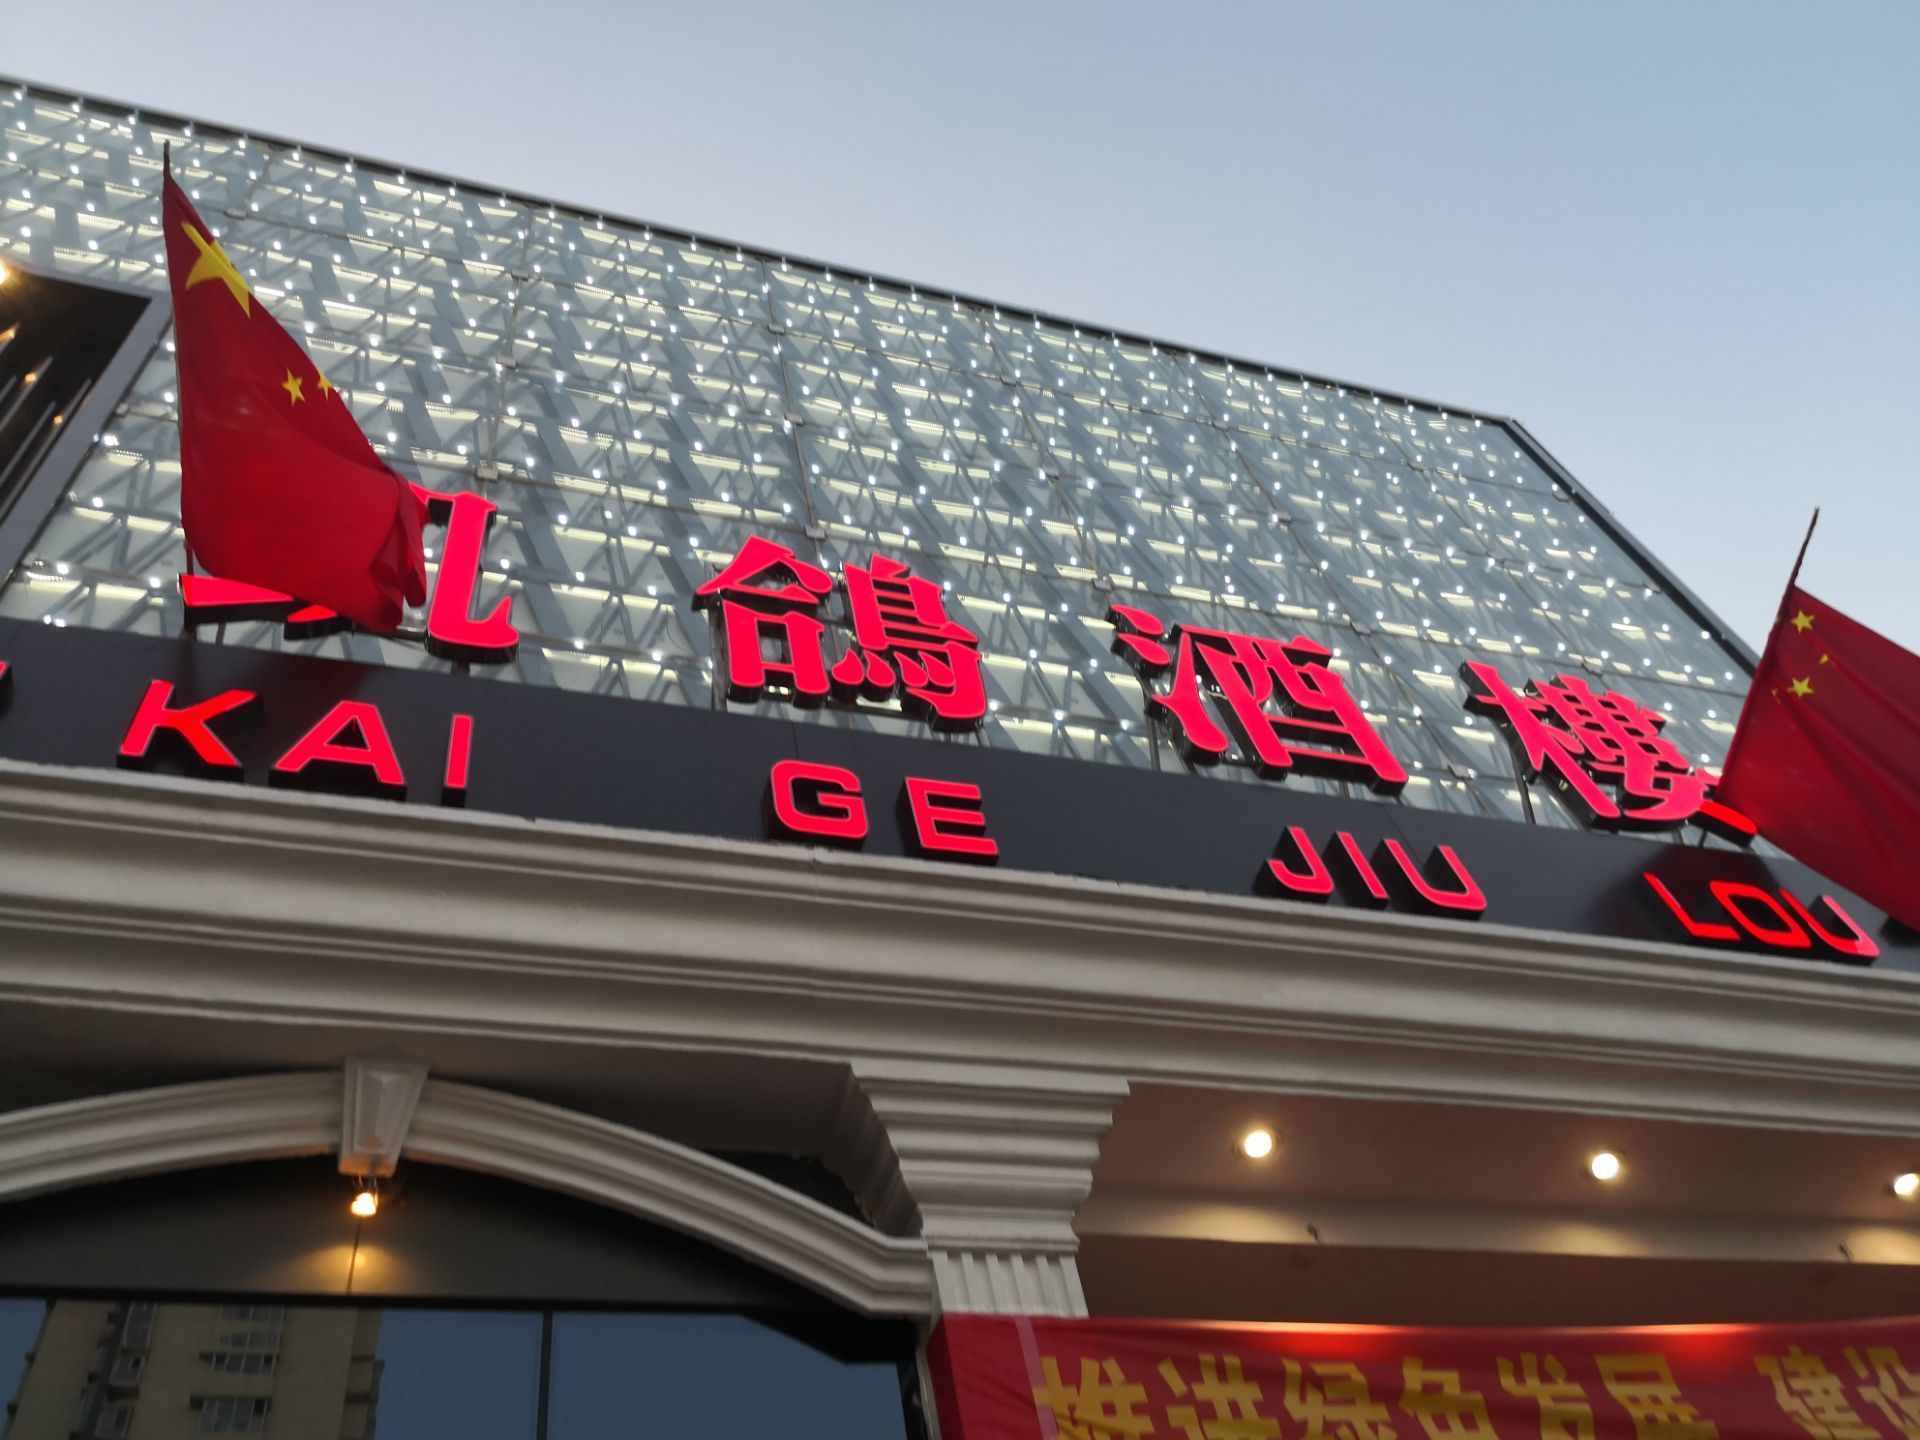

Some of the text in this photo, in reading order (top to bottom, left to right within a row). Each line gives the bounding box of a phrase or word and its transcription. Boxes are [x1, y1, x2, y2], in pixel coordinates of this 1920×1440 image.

[119, 678, 1880, 957] KAI GE JIU LOU
